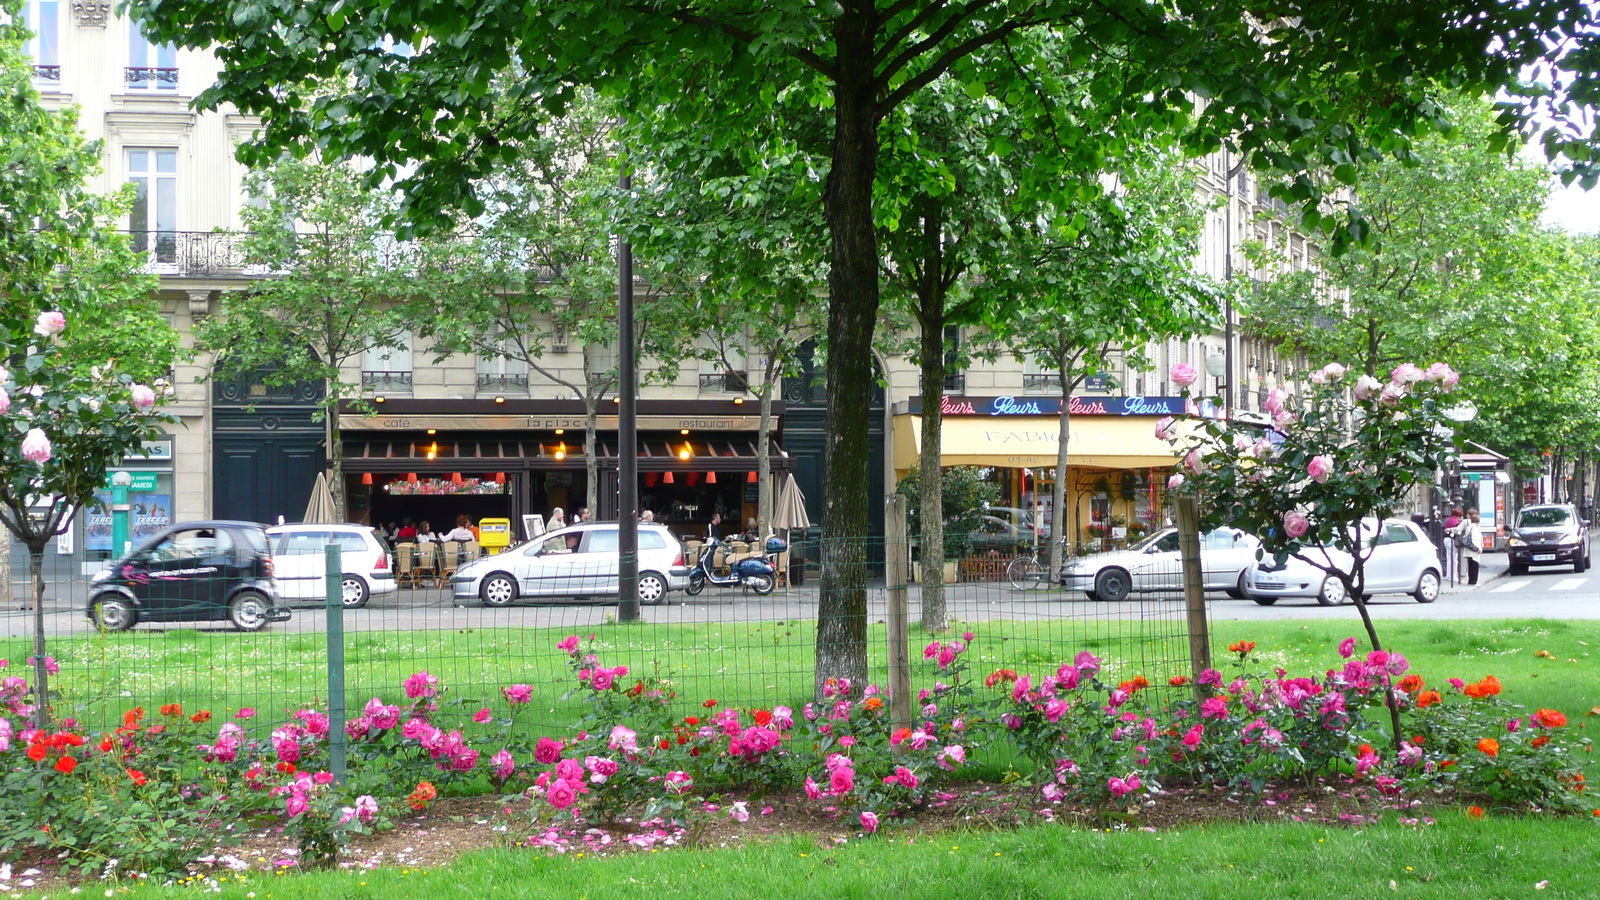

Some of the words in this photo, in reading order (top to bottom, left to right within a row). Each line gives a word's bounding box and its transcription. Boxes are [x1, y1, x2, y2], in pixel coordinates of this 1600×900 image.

[941, 395, 976, 414] leurs
[991, 395, 1042, 416] Fleurs
[1121, 395, 1171, 416] Fleurs
[383, 419, 410, 428] café
[679, 419, 734, 429] restaurant
